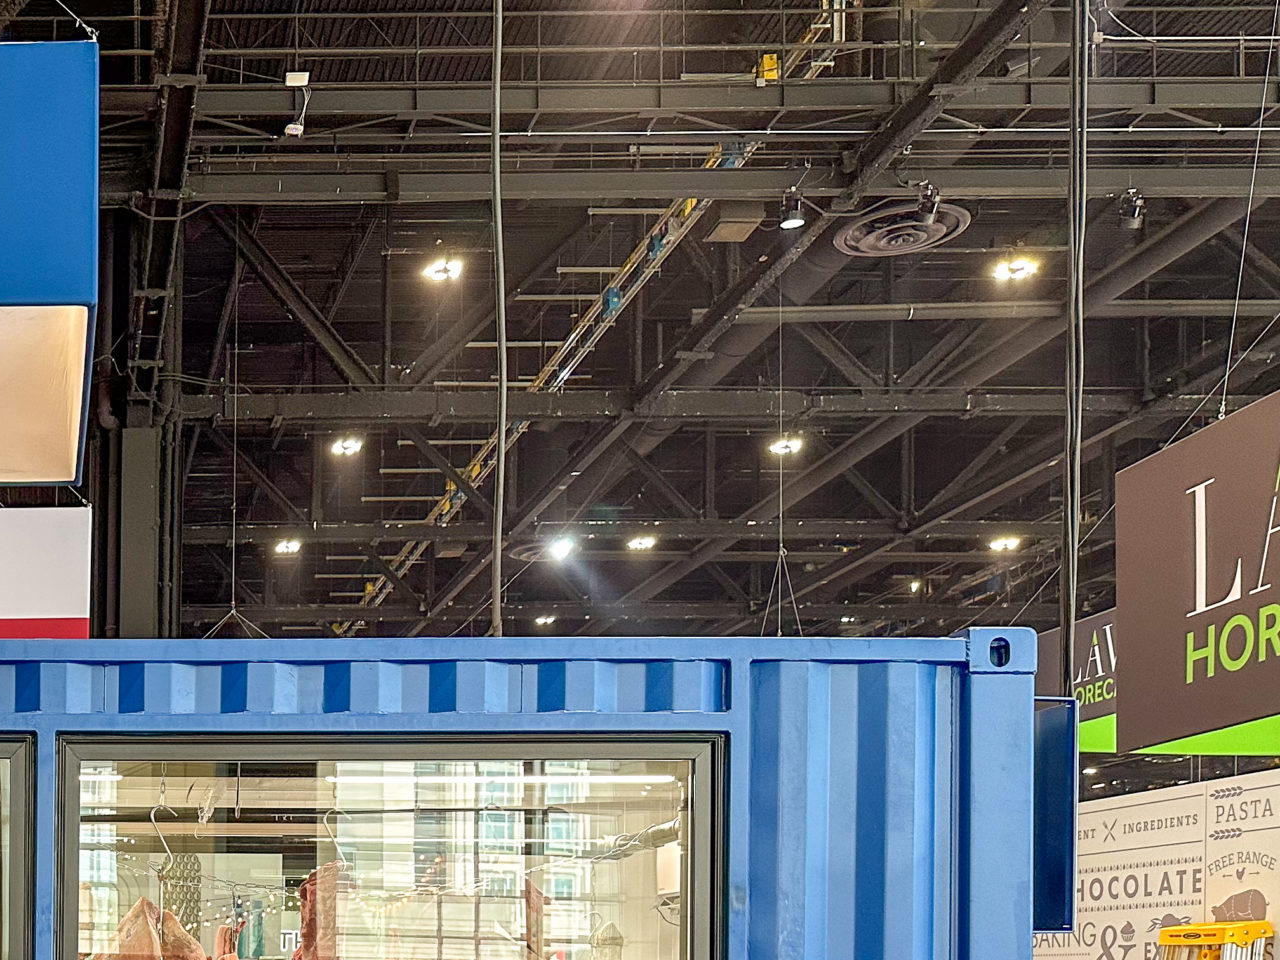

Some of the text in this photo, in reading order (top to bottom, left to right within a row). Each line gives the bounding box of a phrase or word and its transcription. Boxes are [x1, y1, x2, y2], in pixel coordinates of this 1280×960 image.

[1123, 814, 1199, 834] INGREDIENTS
[1215, 798, 1274, 824] PASTA
[1207, 850, 1278, 876] FREE RANGE
